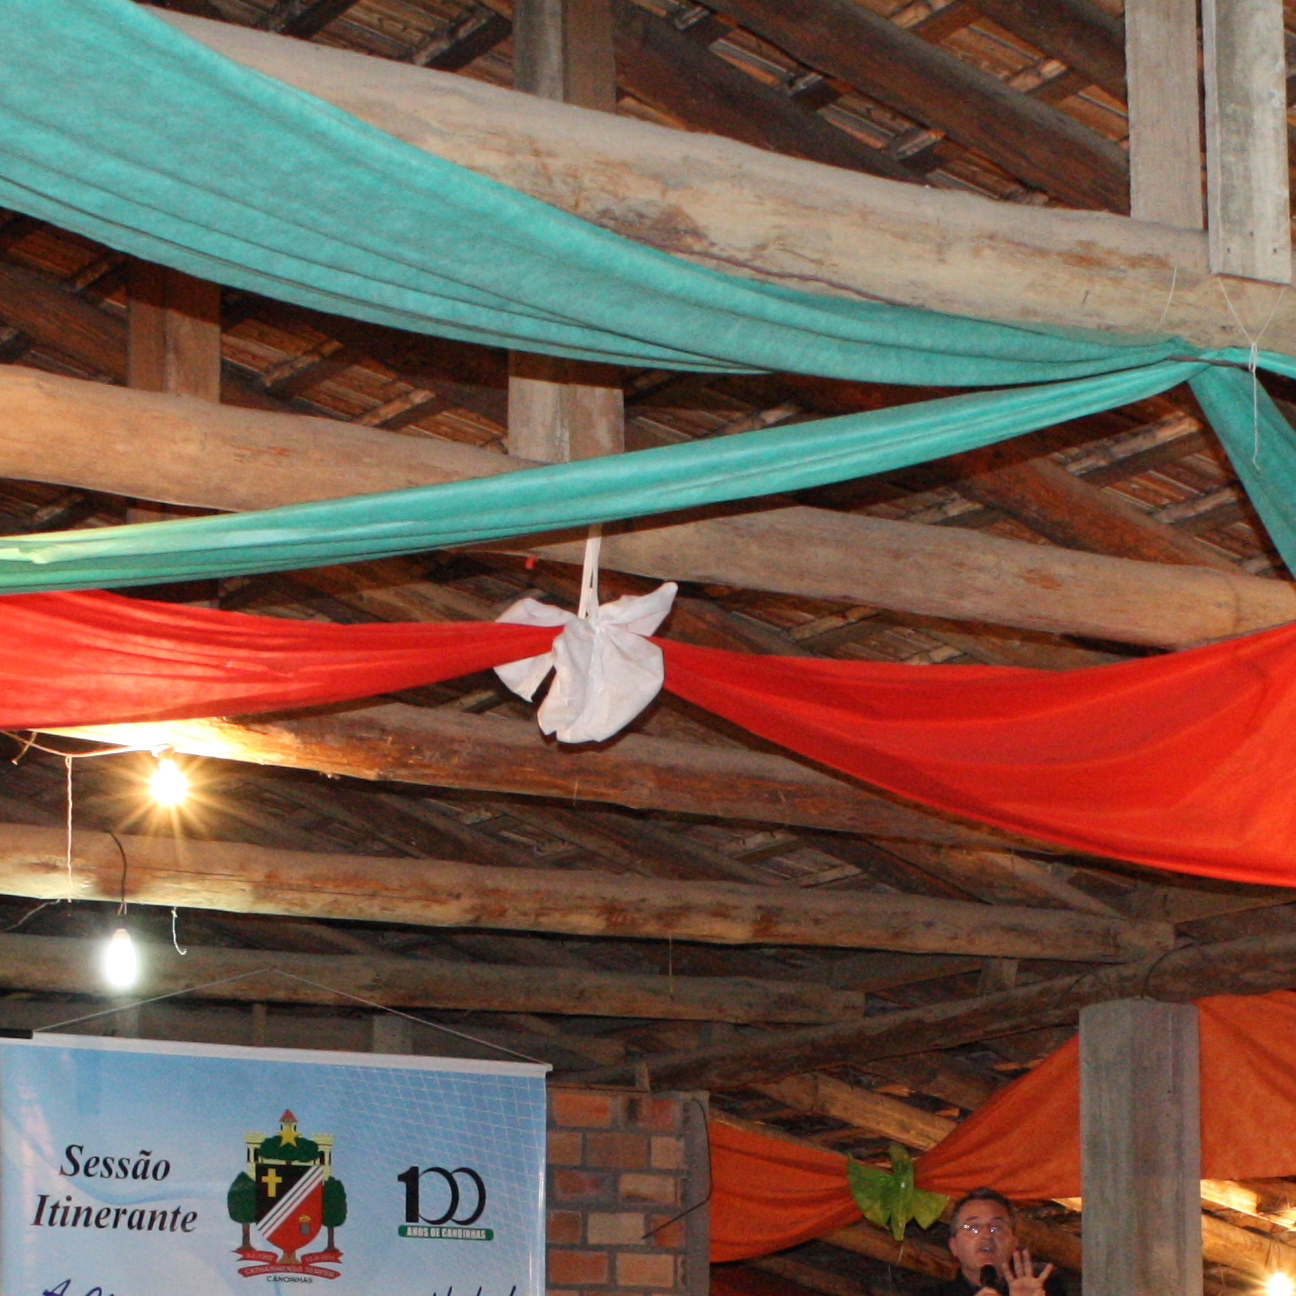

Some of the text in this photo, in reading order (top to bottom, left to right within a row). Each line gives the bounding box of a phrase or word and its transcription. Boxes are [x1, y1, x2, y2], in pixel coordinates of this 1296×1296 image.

[59, 1144, 171, 1181] Sessão
[30, 1194, 198, 1233] Itinerante
[397, 1166, 487, 1226] 100
[406, 1226, 428, 1237] ANOS
[430, 1227, 440, 1237] DE
